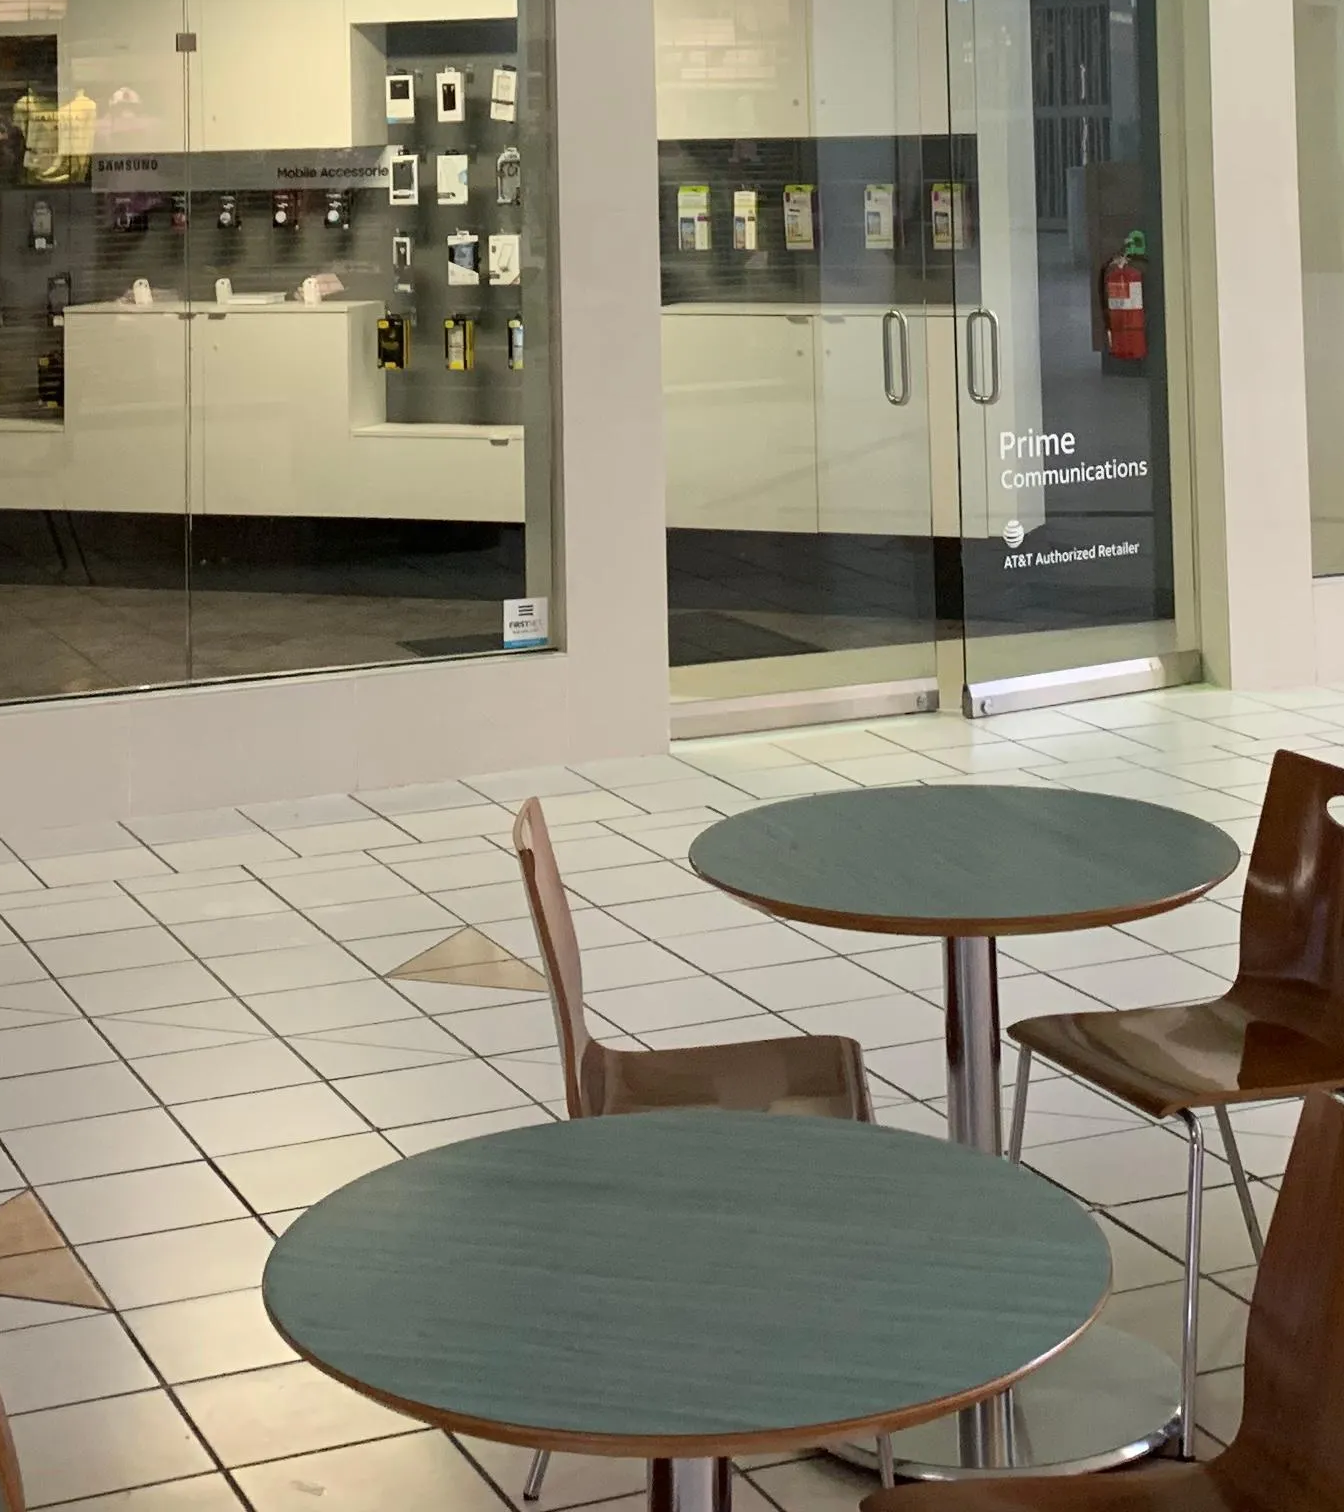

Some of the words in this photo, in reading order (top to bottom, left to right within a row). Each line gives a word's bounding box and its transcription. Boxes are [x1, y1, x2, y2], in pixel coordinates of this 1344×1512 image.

[98, 159, 158, 172] SAMSUNG
[277, 167, 317, 178] Mobile
[320, 167, 389, 178] Accessorie
[999, 428, 1076, 460] Prime
[1001, 459, 1148, 489] Communications
[1003, 553, 1033, 570] AT&T
[1035, 545, 1096, 566] Authorized
[1098, 541, 1141, 558] Retailer
